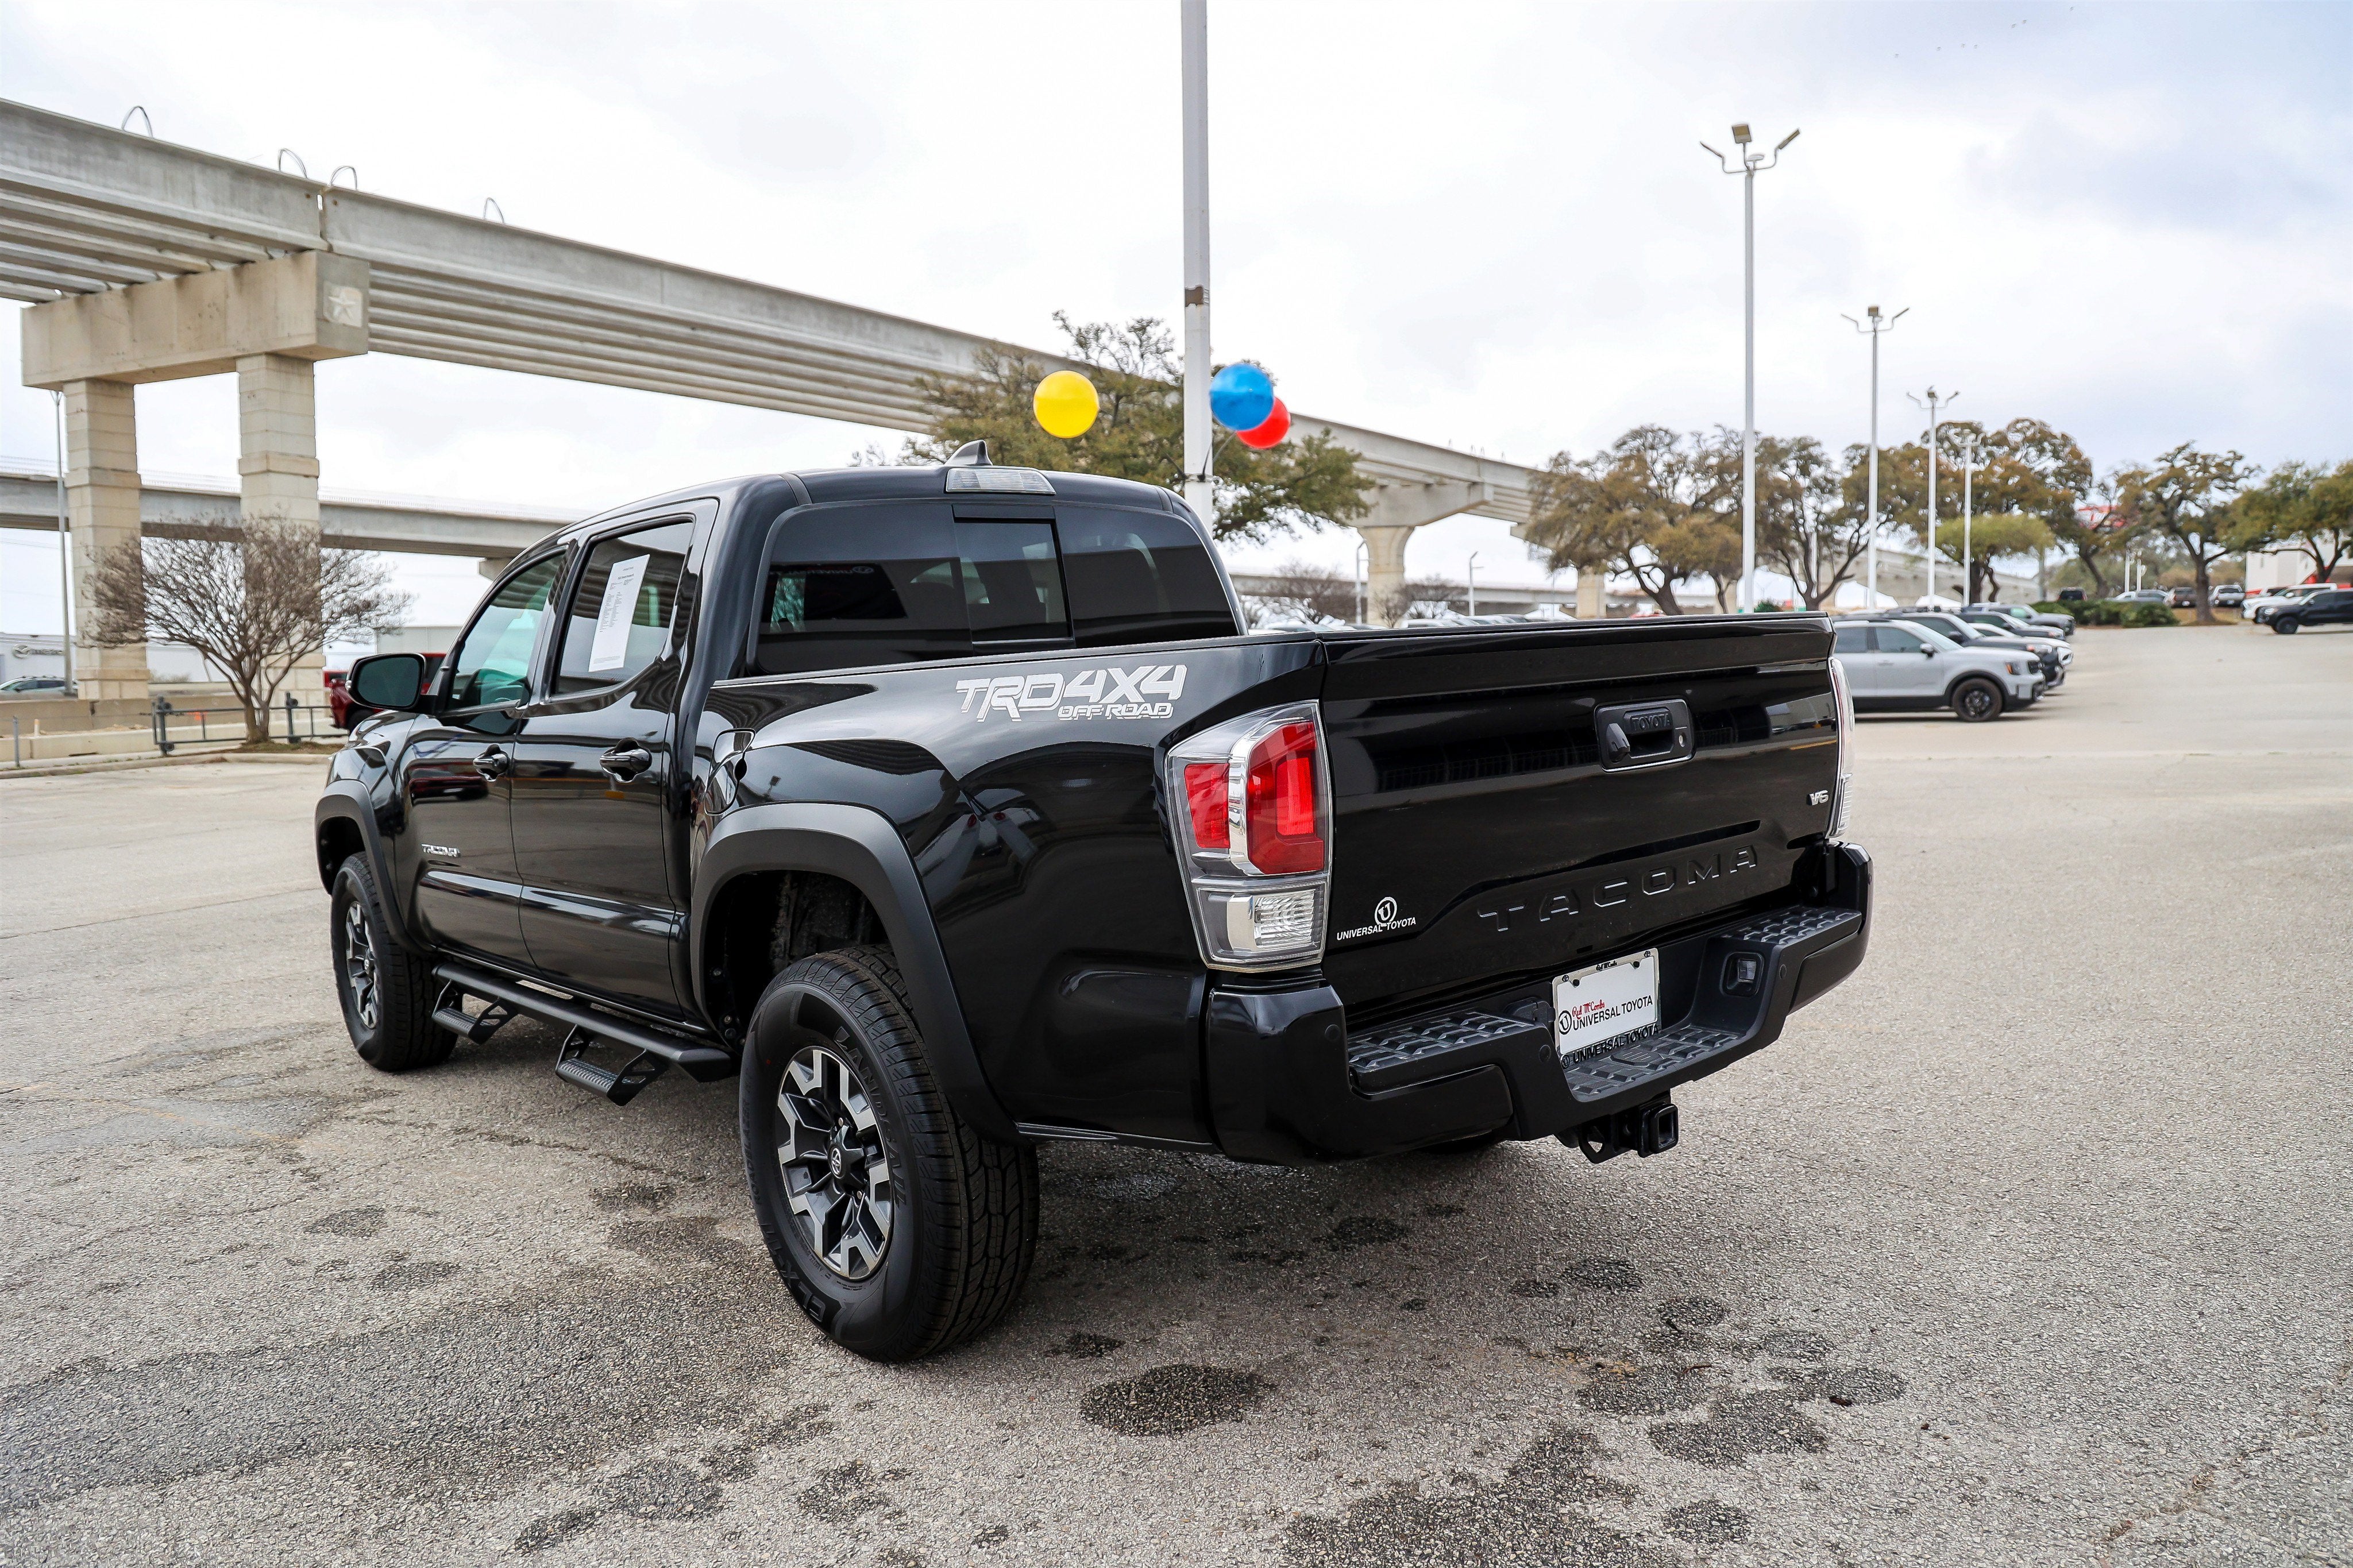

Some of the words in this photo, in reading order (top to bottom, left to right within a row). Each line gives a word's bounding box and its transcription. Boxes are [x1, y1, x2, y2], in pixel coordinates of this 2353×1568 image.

[955, 673, 1064, 722] TRD
[1058, 703, 1104, 721] OFF
[1104, 702, 1173, 720] ROAD
[1809, 790, 1829, 805] V6
[1477, 844, 1758, 932] TACOMA
[1337, 924, 1383, 941] UNIVERSAL
[1386, 917, 1417, 930] TOYOTA
[1572, 1005, 1583, 1020] Red
[1573, 1005, 1621, 1031] UNIVERSAL
[1621, 995, 1653, 1014] TOYOTA
[1573, 1036, 1624, 1063] UNIVERSAL
[1624, 1023, 1659, 1044] TOYOTA
